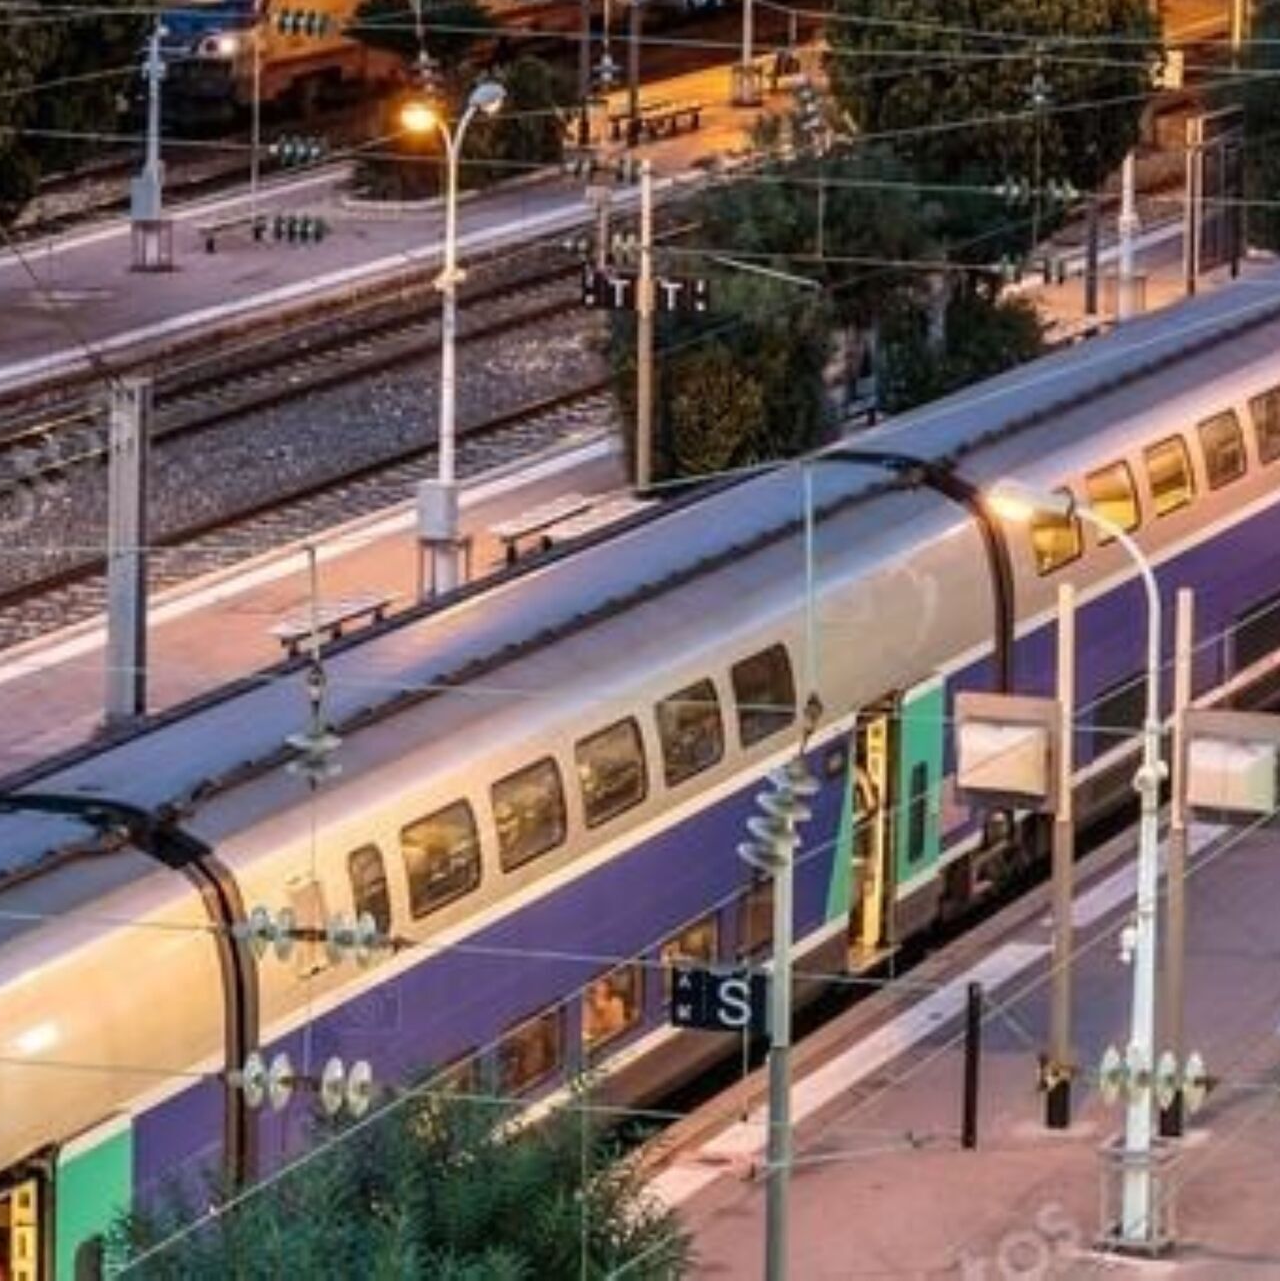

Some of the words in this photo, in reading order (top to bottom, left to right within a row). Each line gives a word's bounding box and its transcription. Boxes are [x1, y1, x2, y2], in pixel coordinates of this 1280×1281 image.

[609, 278, 631, 308] T
[660, 281, 683, 311] T
[716, 978, 752, 1026] S
